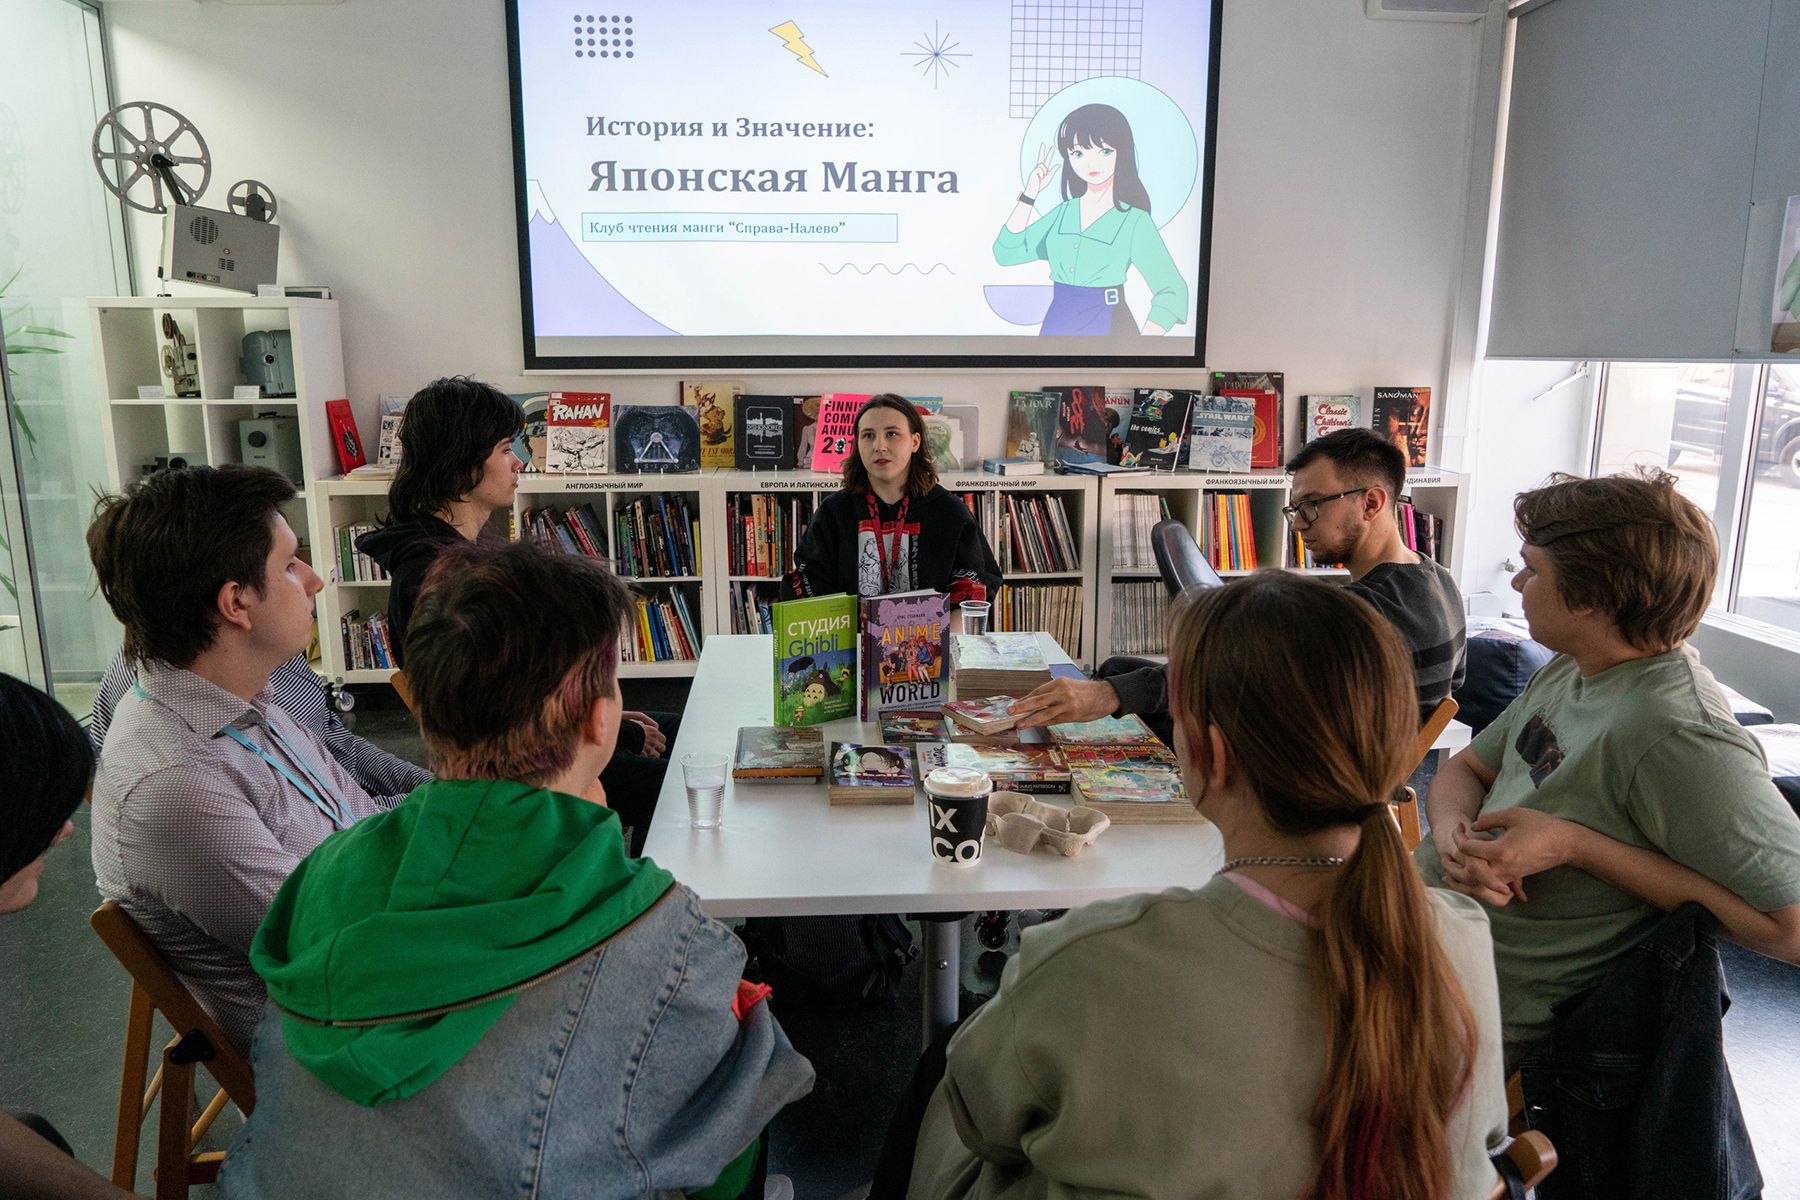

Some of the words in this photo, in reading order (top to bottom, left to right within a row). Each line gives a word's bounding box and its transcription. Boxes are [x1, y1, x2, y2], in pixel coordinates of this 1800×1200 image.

[586, 116, 703, 141] История
[711, 122, 728, 137] и
[736, 117, 875, 138] Значение:
[587, 160, 808, 193] Японская
[822, 161, 960, 194] Манга
[589, 221, 625, 236] Клуб
[628, 224, 678, 234] чтения
[682, 224, 725, 234] манги
[1376, 390, 1419, 400] SANDMAN
[552, 402, 605, 422] RAHAN
[1317, 403, 1348, 416] Classic
[1313, 415, 1353, 427] Children's
[565, 482, 627, 490] АНГЛОЯЗЫЧНЫЙ
[955, 480, 1020, 488] ФРАНКОЯЗЫЧНЫЙ
[1205, 478, 1268, 486] ФРАНКОЯЗЫЧНЫЙ
[1269, 478, 1285, 486] МИР
[881, 622, 942, 646] ANIME
[788, 632, 839, 659] Ghibli
[879, 680, 941, 705] WORLD
